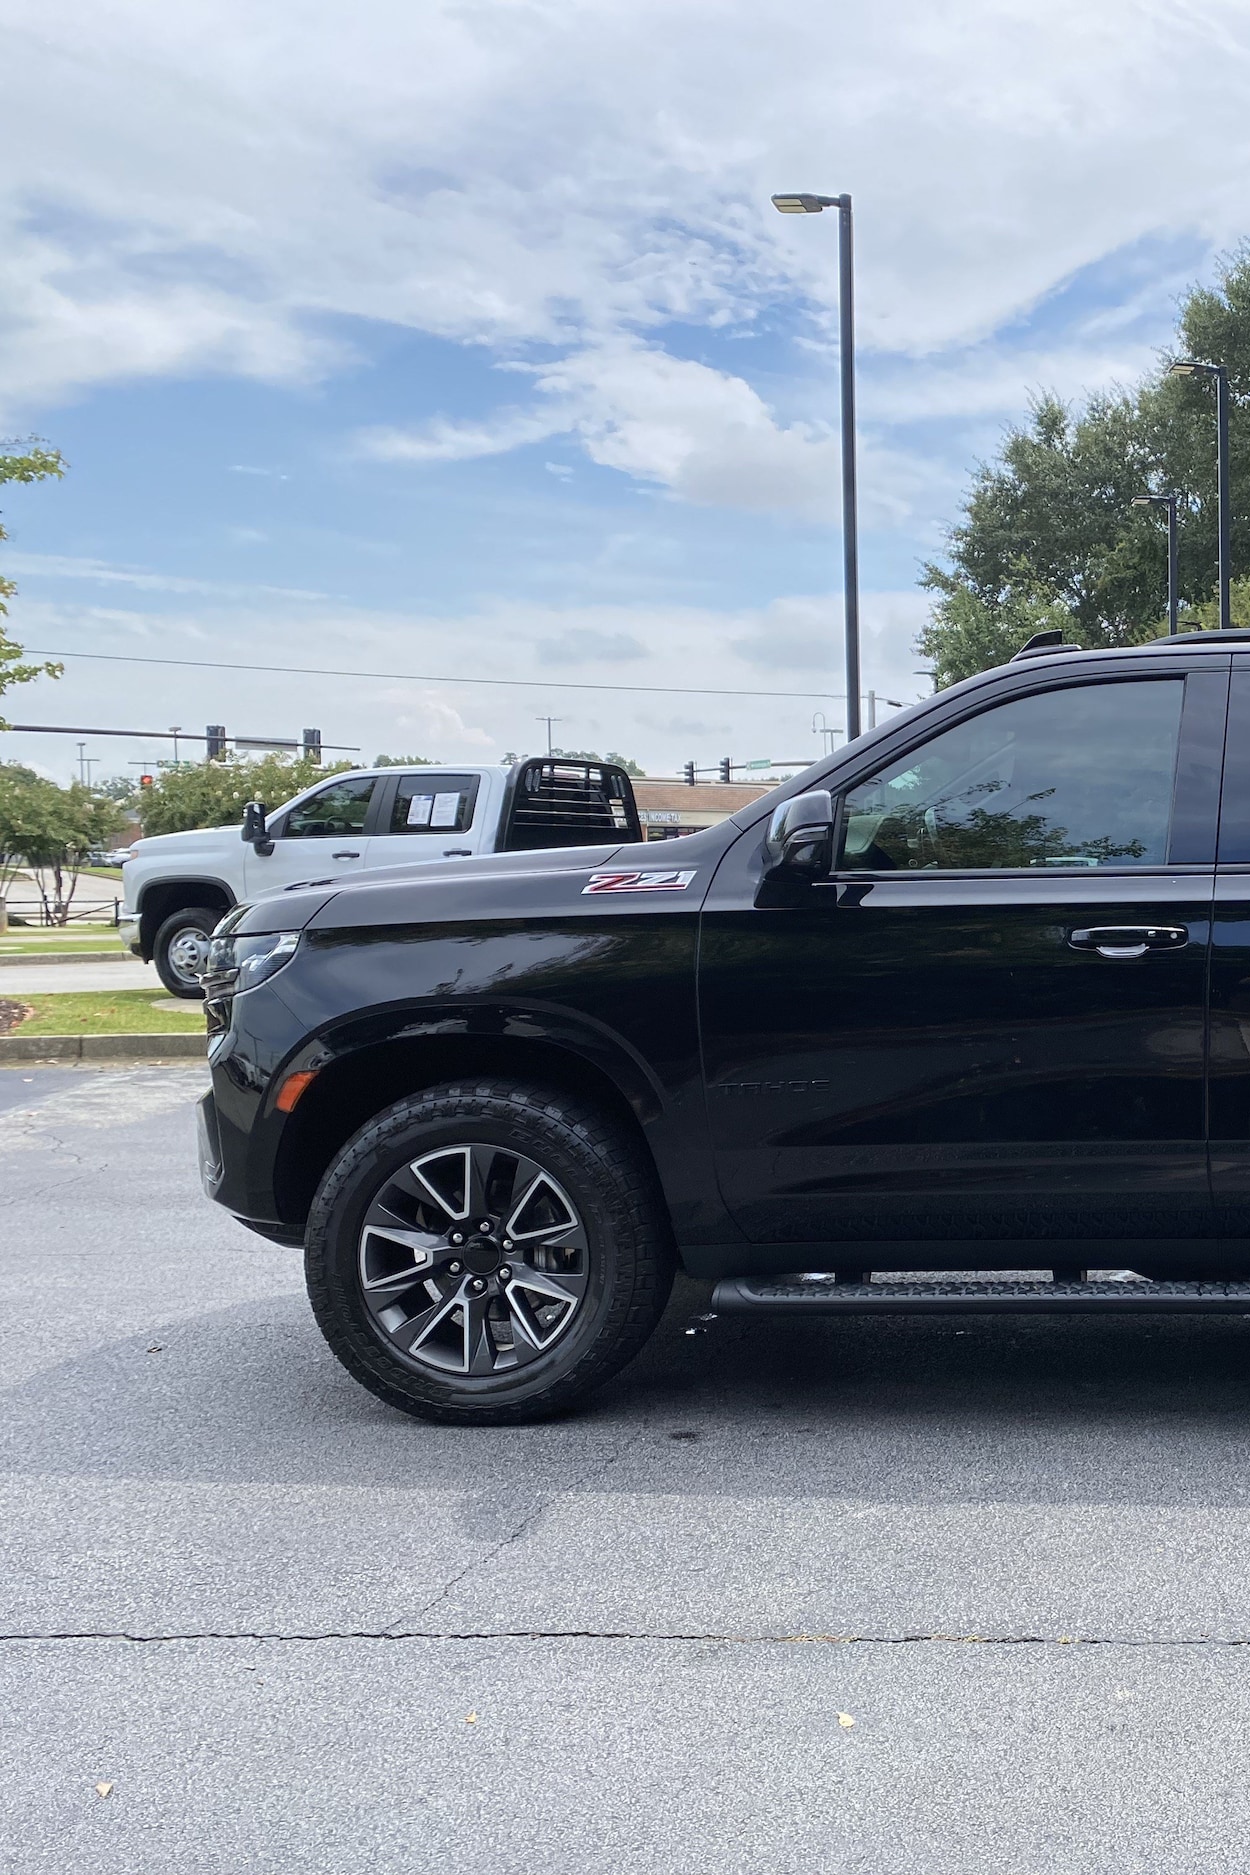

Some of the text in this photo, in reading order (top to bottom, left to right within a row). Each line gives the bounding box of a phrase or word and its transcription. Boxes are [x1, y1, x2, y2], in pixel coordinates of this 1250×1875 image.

[671, 813, 681, 823] TAX
[581, 870, 698, 895] Z71
[718, 1079, 830, 1095] TAHOE
